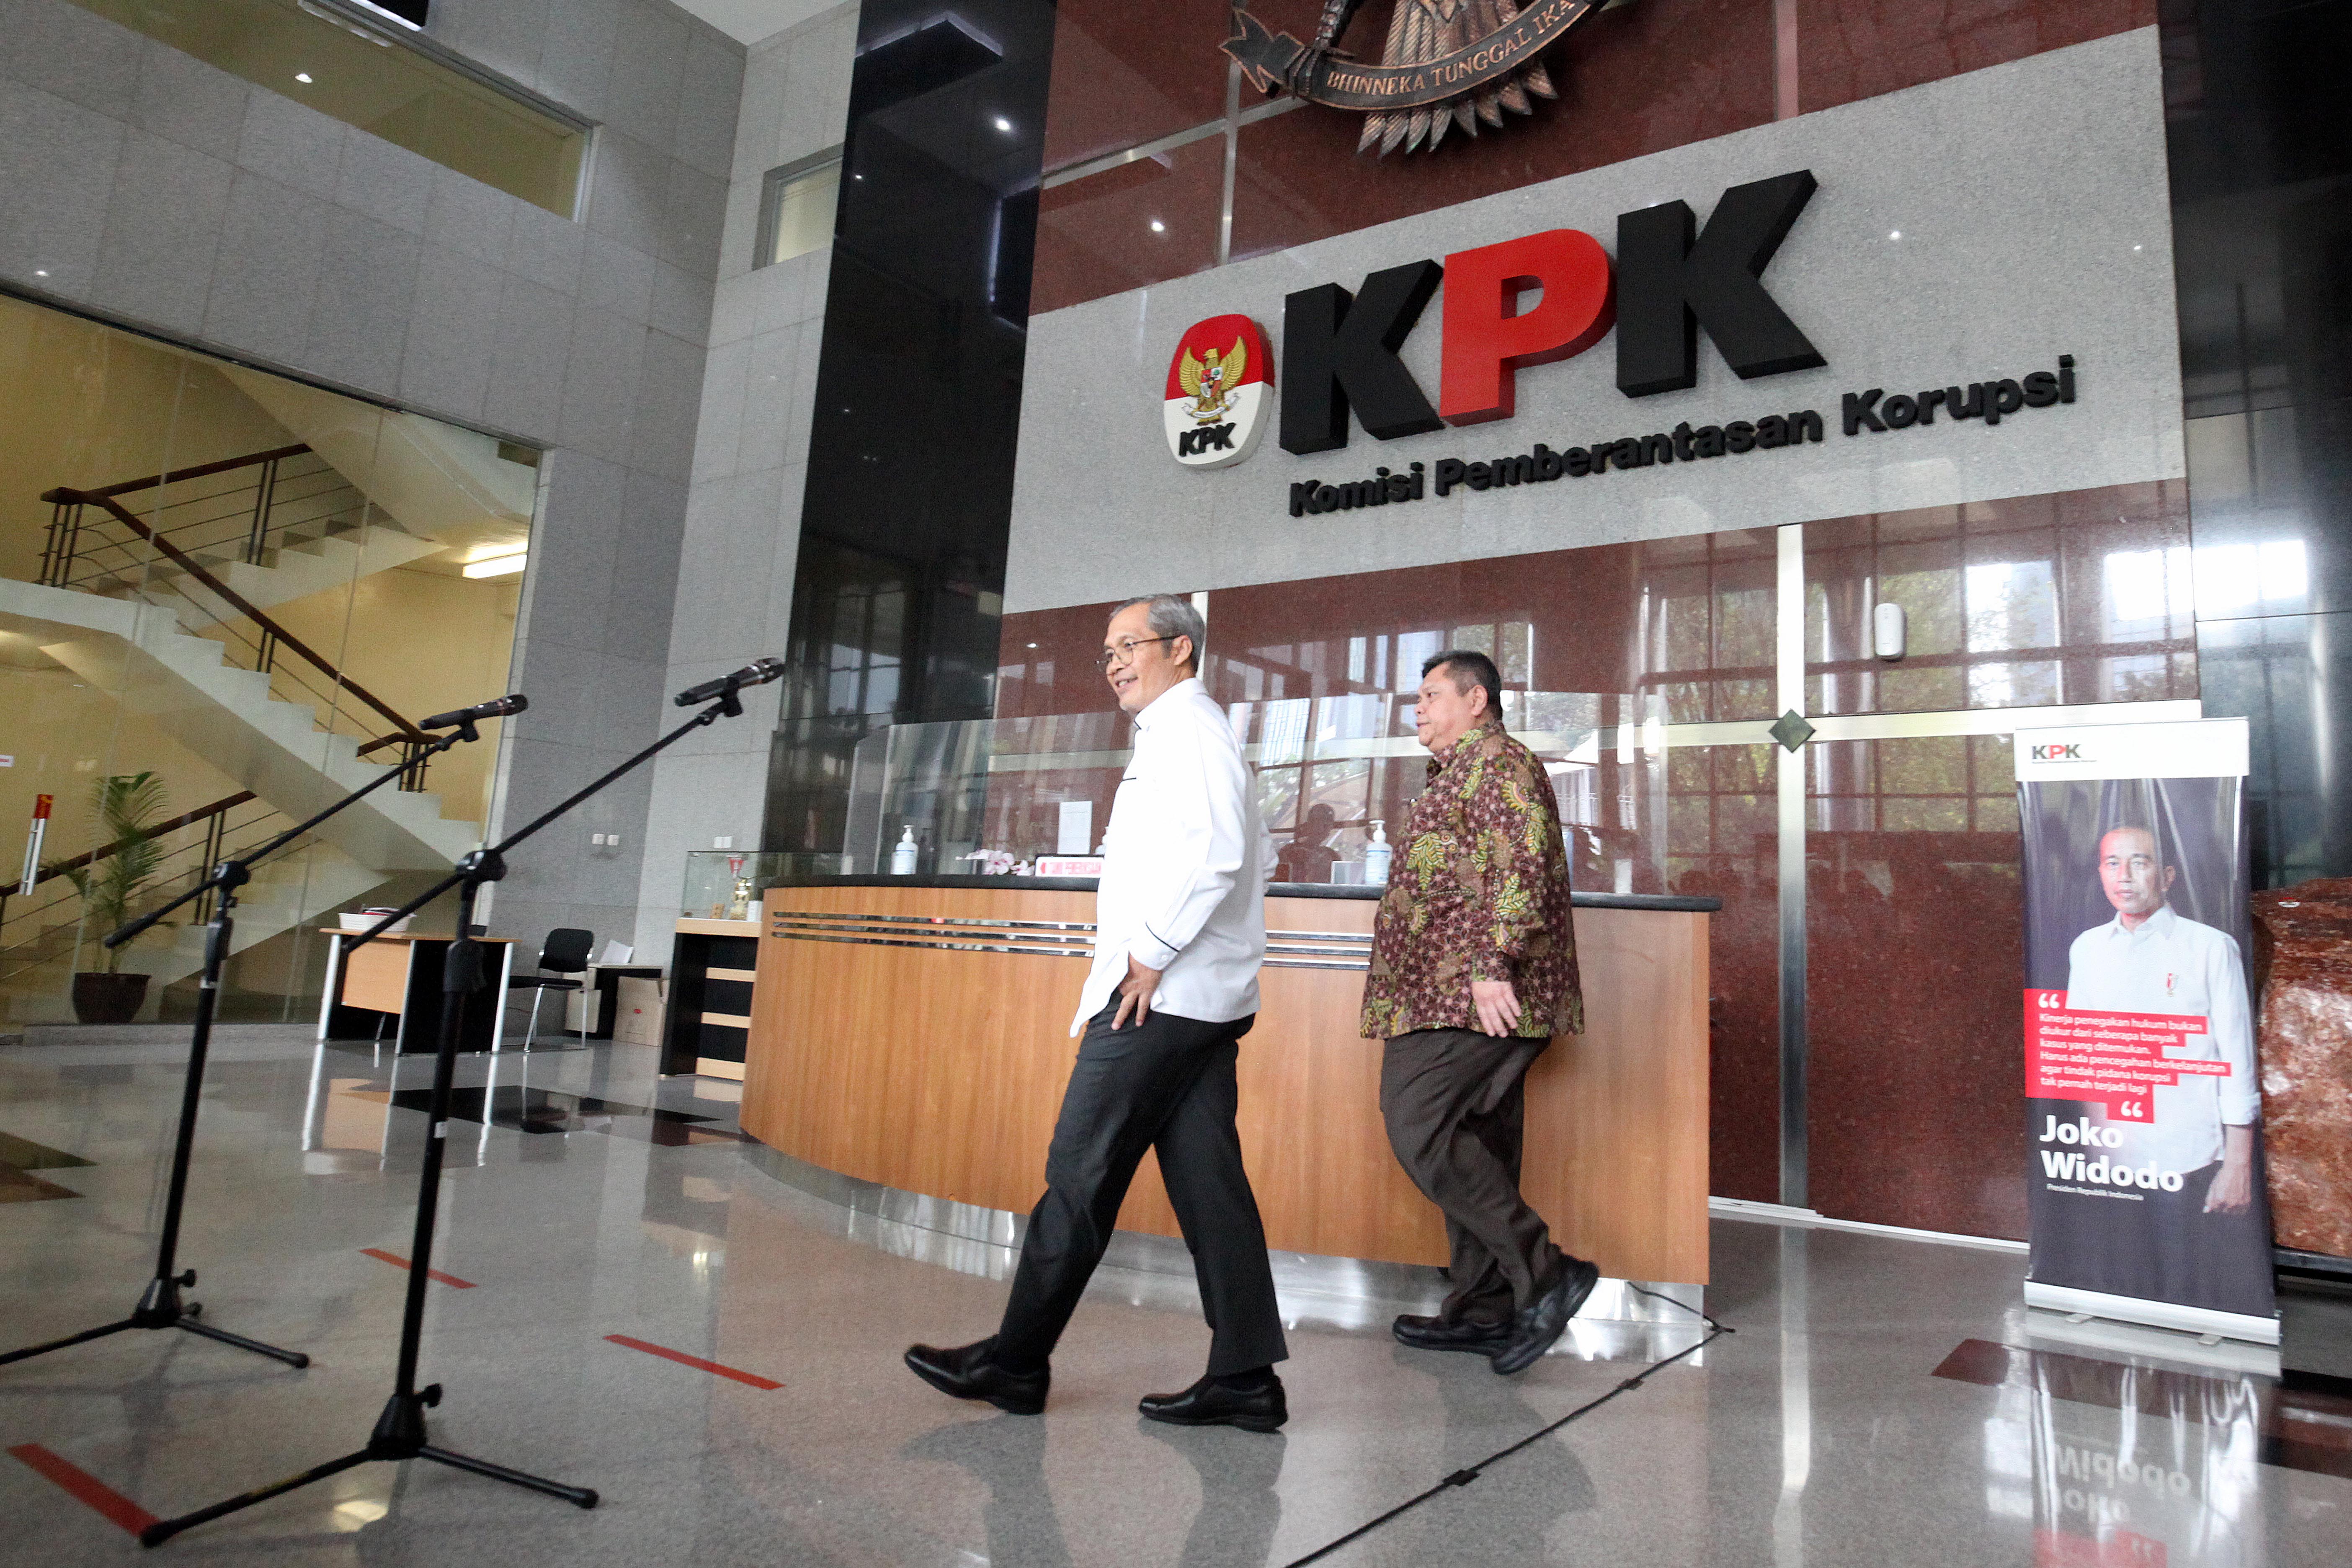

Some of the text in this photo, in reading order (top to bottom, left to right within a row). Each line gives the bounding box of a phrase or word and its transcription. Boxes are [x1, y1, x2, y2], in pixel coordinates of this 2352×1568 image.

[1327, 0, 1575, 95] BHINNEKA TUNGGAL IKA
[1279, 169, 1828, 456] KPK
[1179, 422, 1236, 457] KPK
[1289, 354, 2076, 517] Komisi Pemberantasan Korupsi
[2032, 744, 2081, 759] KPK
[2039, 1013, 2203, 1031] Kinerja penegakan hukum bukan
[2039, 1038, 2067, 1048] kasus
[2068, 1042, 2093, 1052] yang
[2072, 1028, 2092, 1037] dari
[2092, 1029, 2139, 1042] seberapa
[2140, 1032, 2178, 1044] banyak
[2039, 1051, 2226, 1073] Harus ada pencegahan berkelanjutan
[2040, 1065, 2171, 1083] agar tindak pidana korupsi
[2040, 1077, 2057, 1086] tak
[2093, 1081, 2127, 1093] terjadi
[2127, 1083, 2147, 1096] lagi
[2039, 1114, 2124, 1148] Joko
[2040, 1150, 2184, 1192] Widodo
